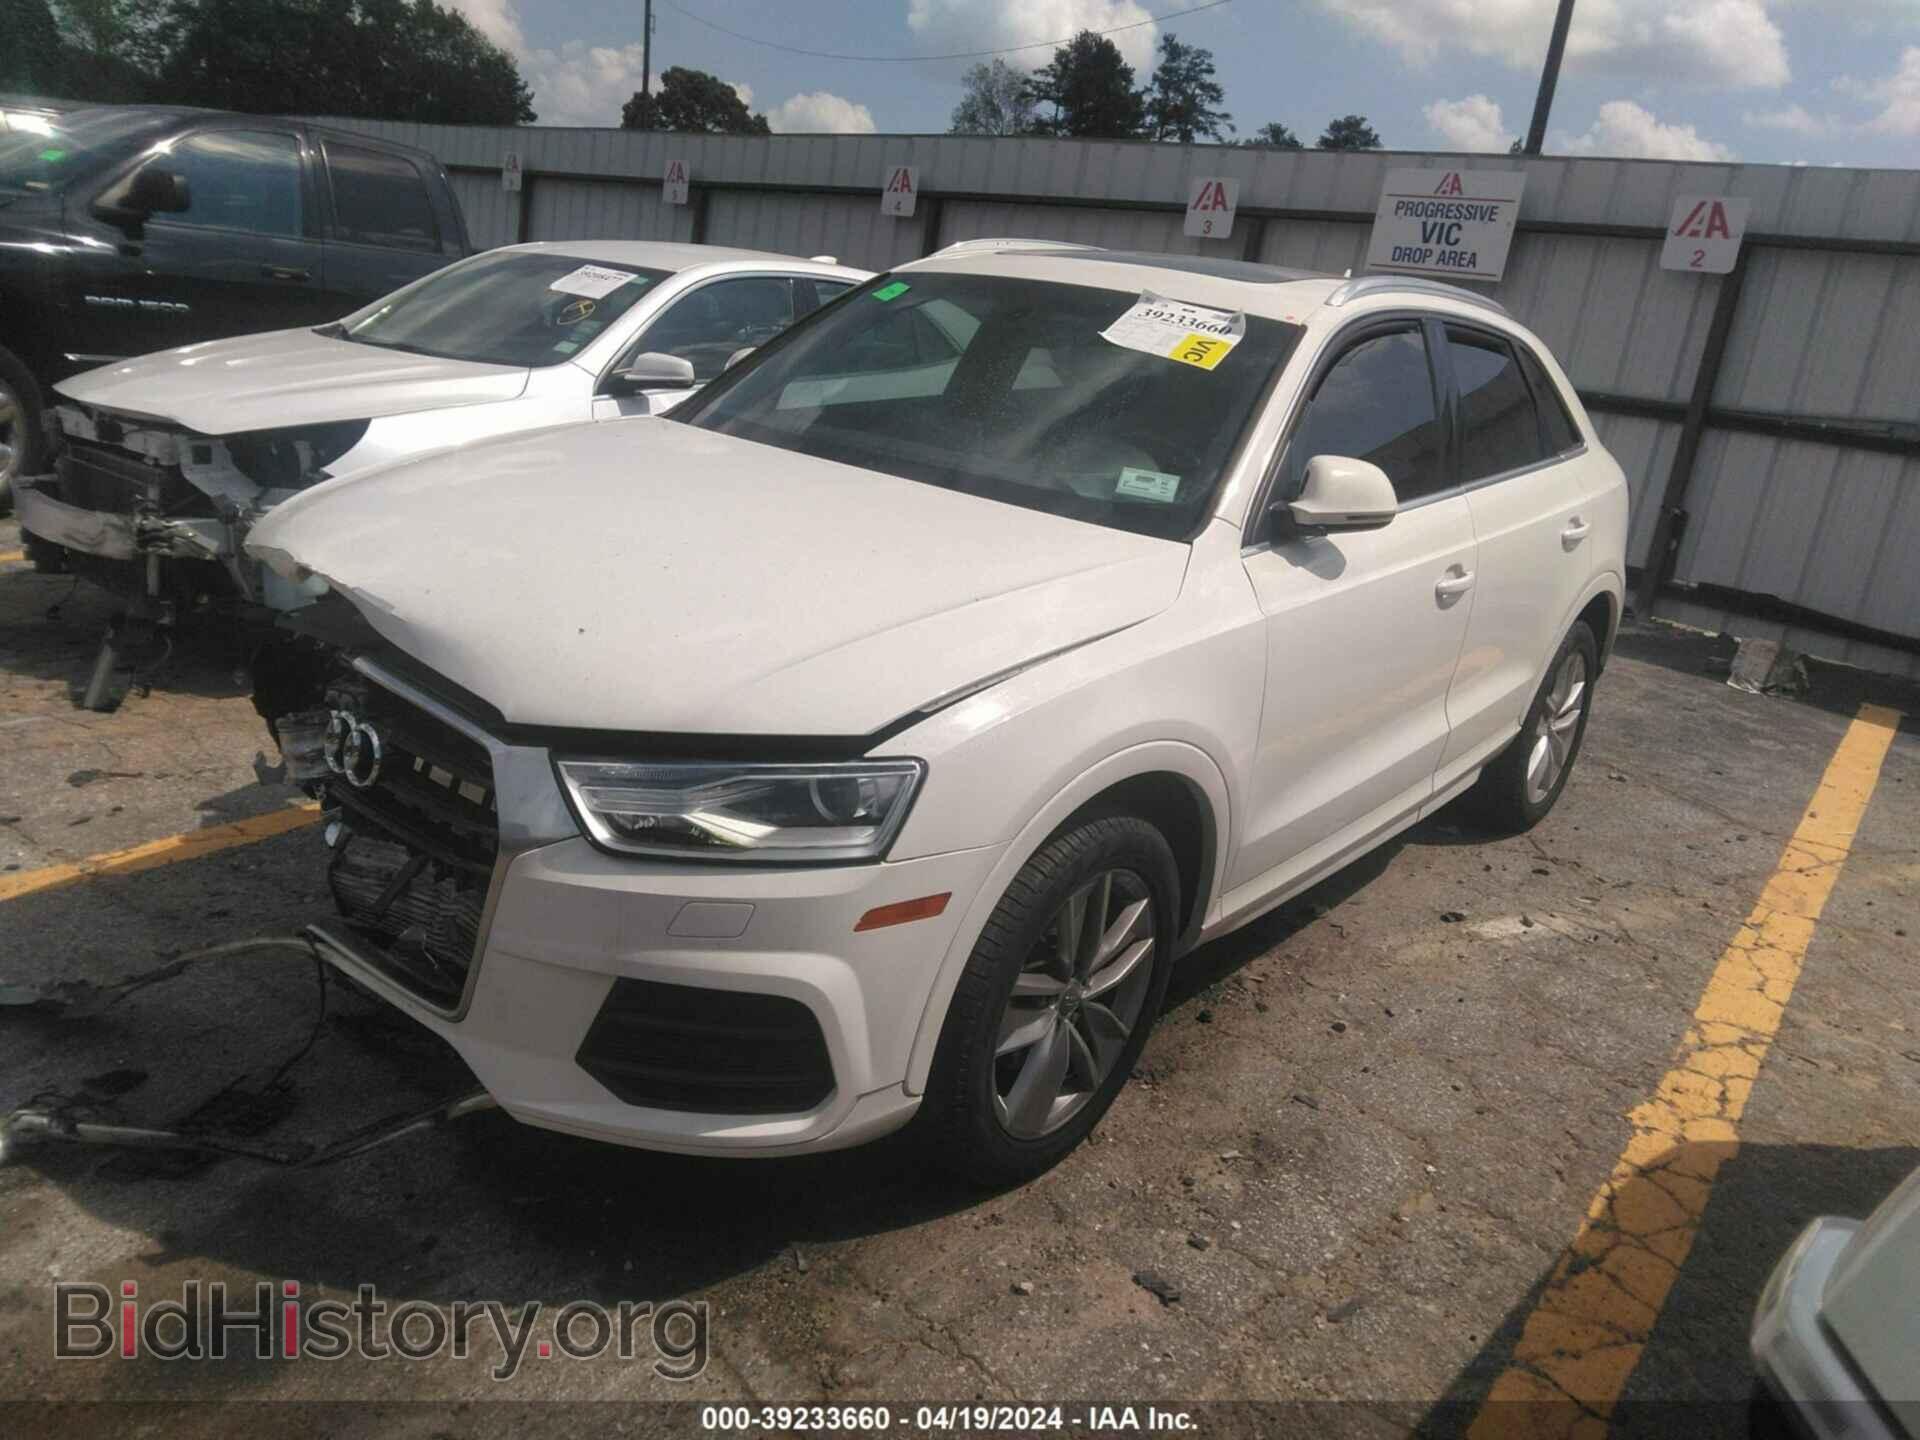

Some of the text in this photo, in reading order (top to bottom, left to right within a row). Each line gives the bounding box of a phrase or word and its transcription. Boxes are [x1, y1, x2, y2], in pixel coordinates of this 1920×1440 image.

[1394, 200, 1499, 222] PROGRESSIVE
[1203, 220, 1213, 234] 3
[1421, 221, 1463, 246] VIC
[1391, 246, 1477, 268] DROP AREA
[1690, 249, 1705, 267] 2
[1137, 308, 1232, 336] 39233660
[1183, 340, 1217, 362] VIC
